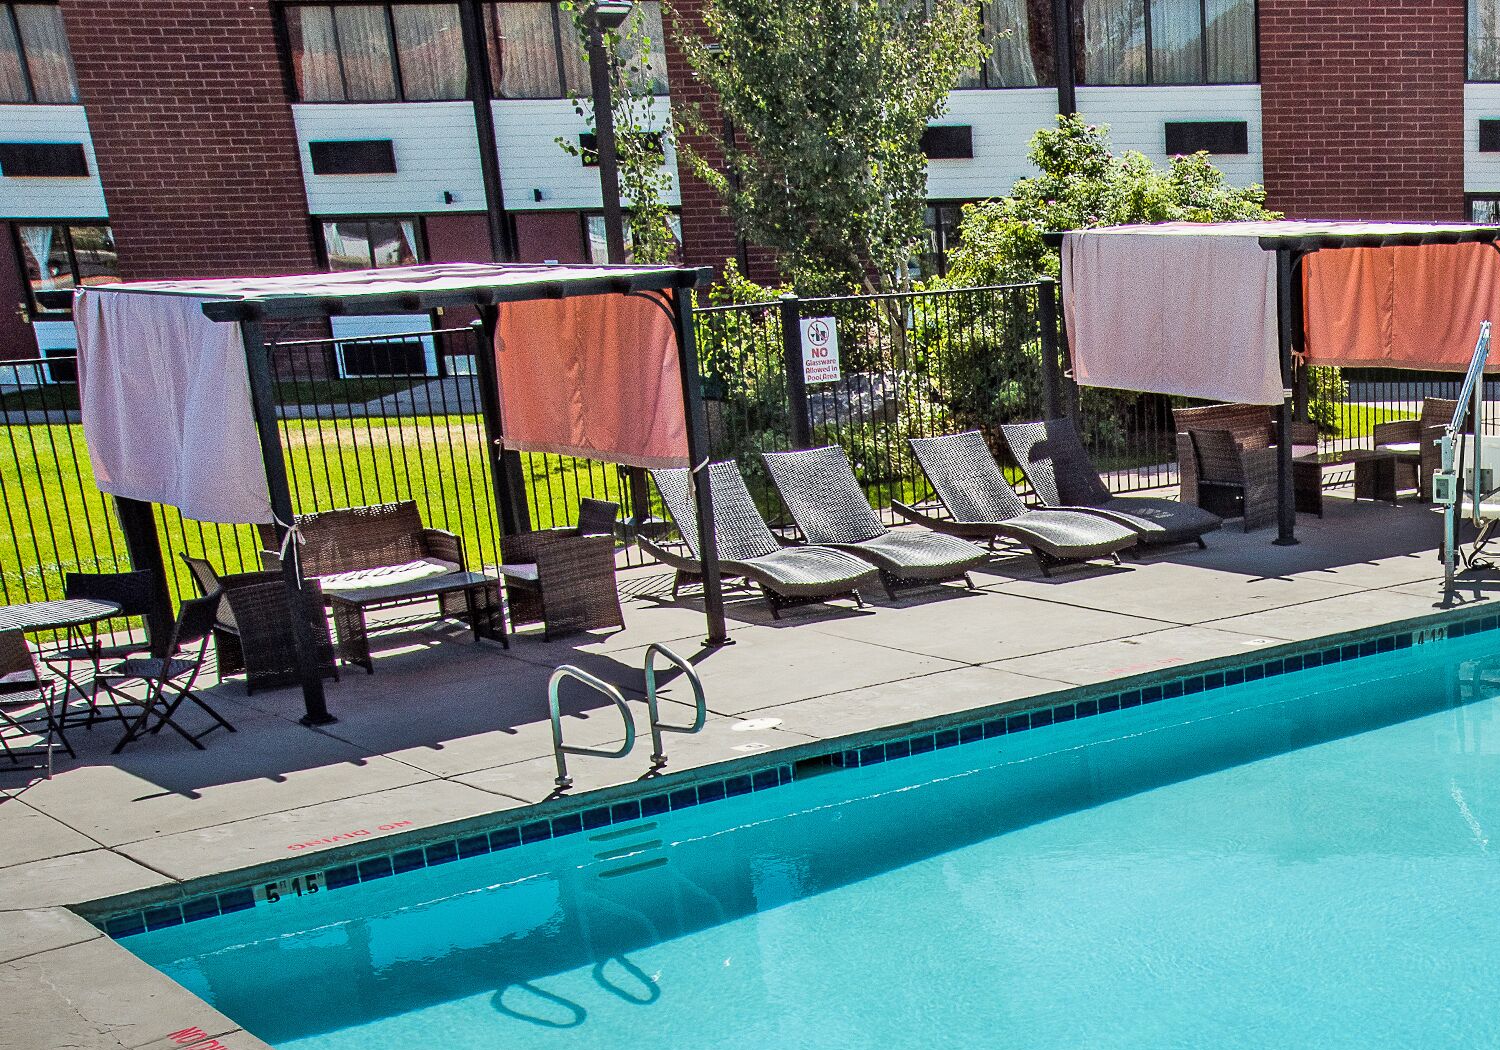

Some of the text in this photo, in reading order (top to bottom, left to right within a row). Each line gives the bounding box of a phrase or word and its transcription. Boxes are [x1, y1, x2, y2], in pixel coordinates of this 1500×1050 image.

[811, 347, 828, 358] NO
[264, 882, 280, 904] 5
[166, 1026, 208, 1044] NO
